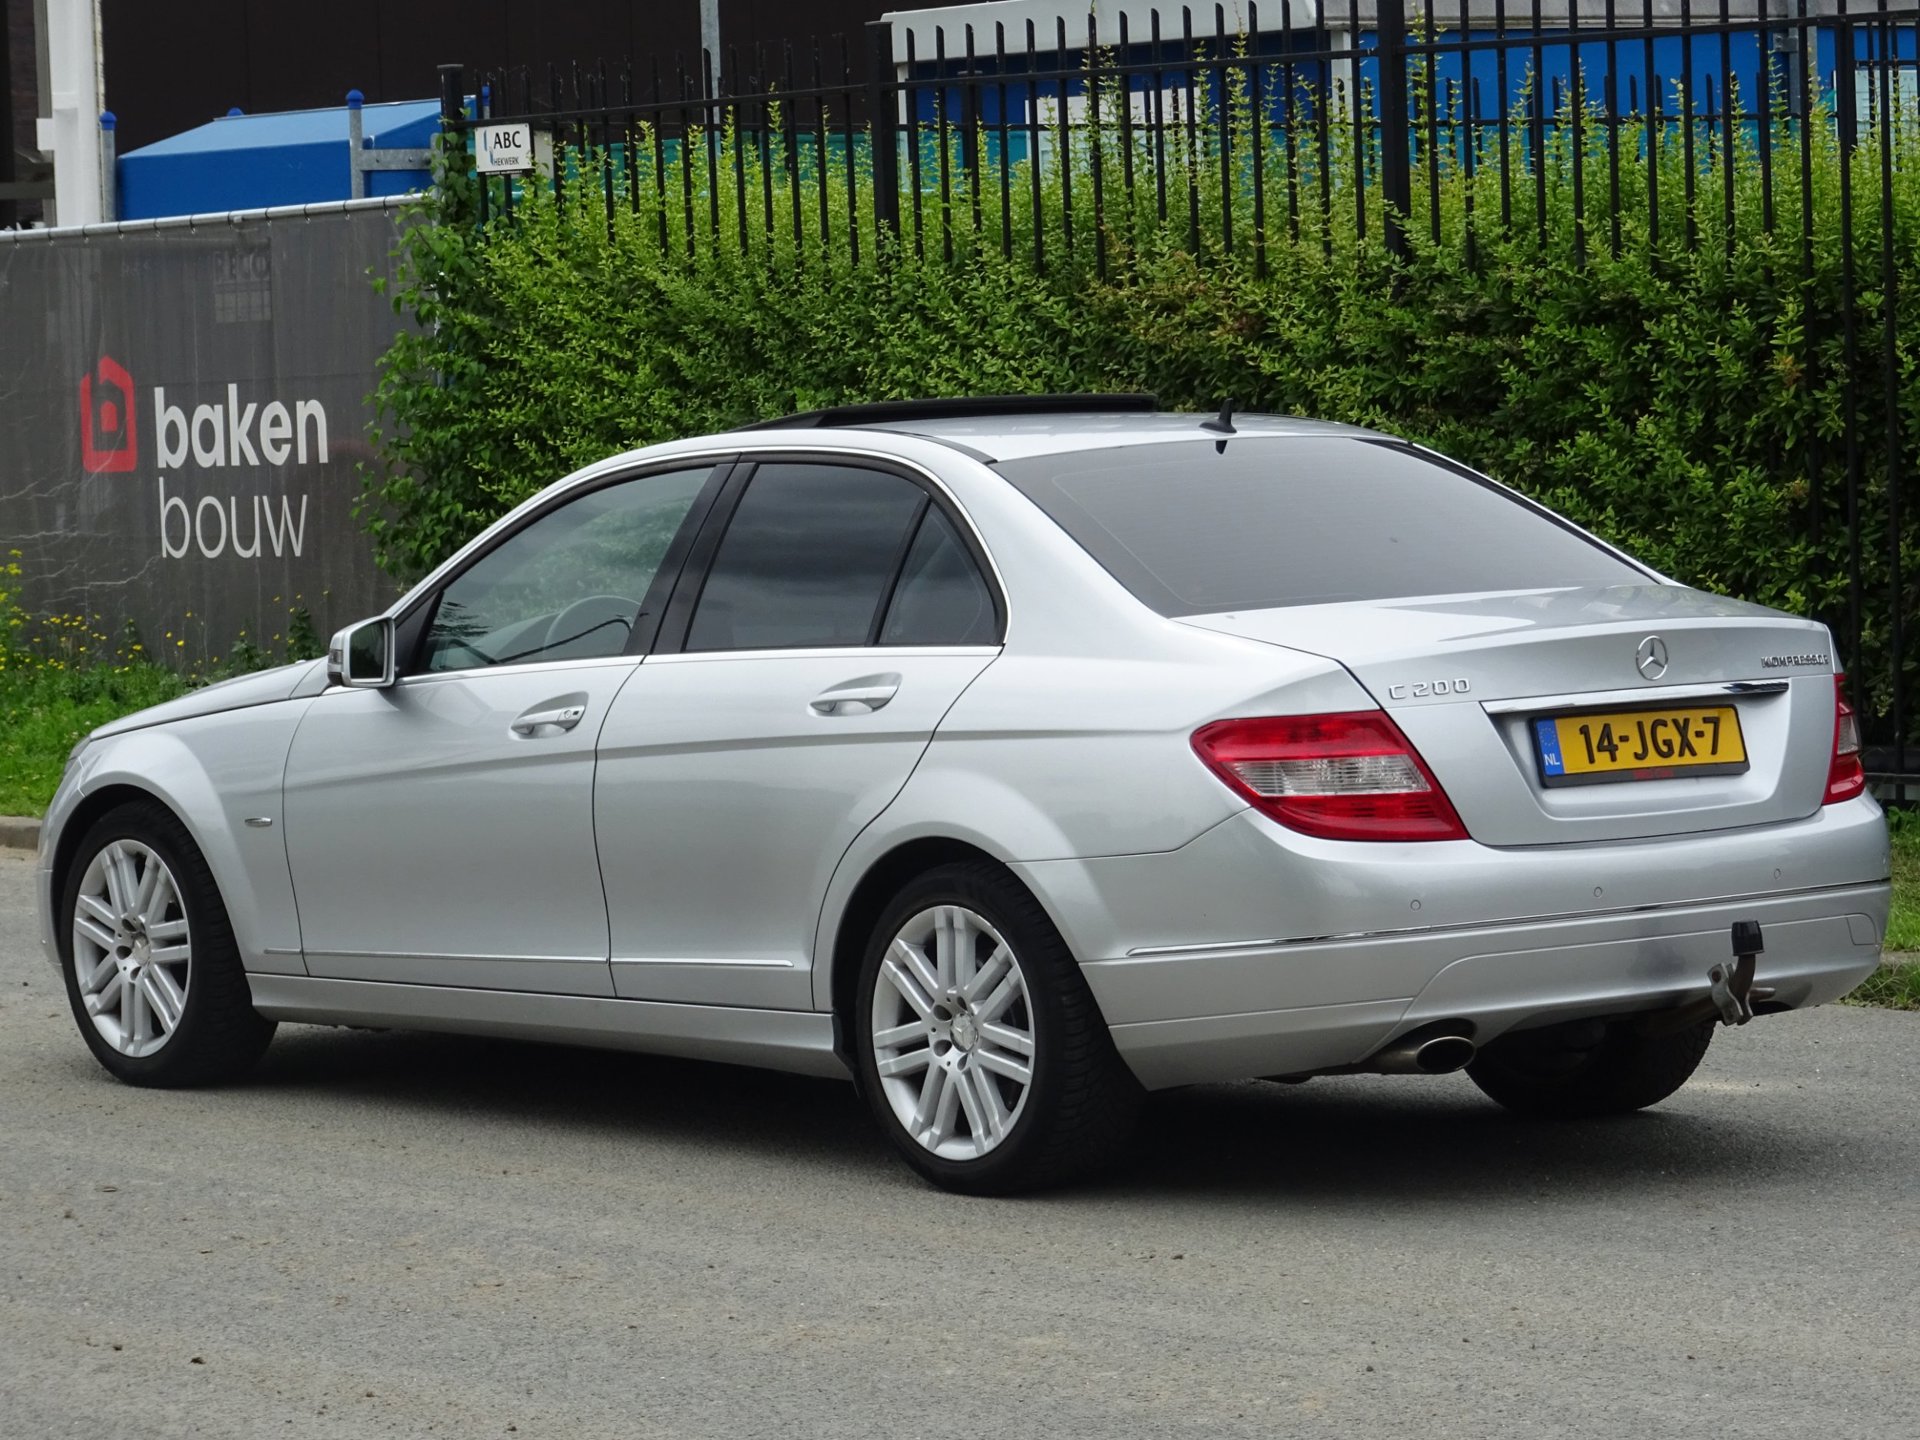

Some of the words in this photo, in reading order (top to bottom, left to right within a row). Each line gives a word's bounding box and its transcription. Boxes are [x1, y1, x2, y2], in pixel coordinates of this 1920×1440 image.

[493, 131, 522, 149] ABC
[494, 156, 520, 166] HEKWERK
[154, 383, 329, 469] baken
[158, 476, 308, 558] bouw
[1389, 684, 1407, 700] C
[1412, 678, 1471, 697] 200
[1579, 716, 1721, 764] 14-JGX-7
[1544, 753, 1561, 767] NL
